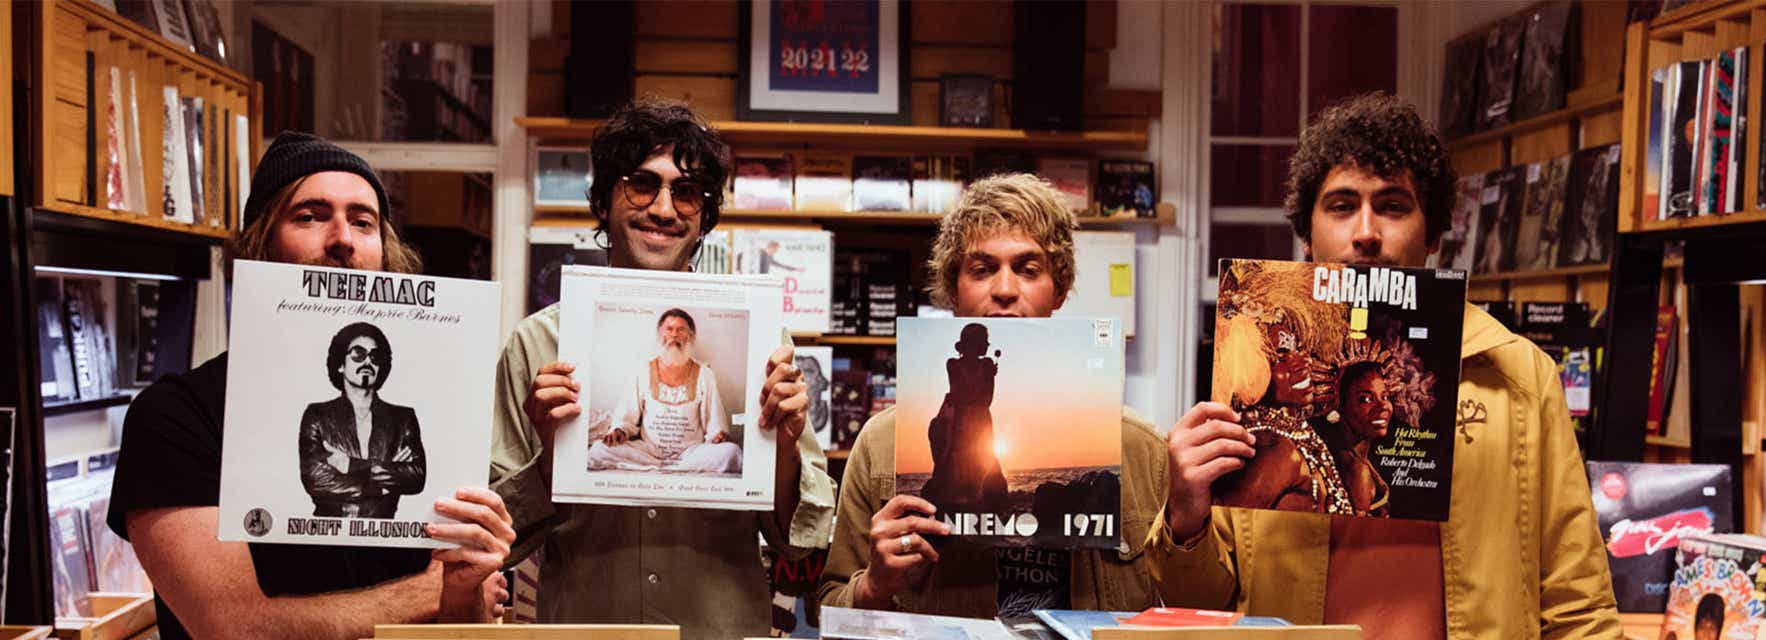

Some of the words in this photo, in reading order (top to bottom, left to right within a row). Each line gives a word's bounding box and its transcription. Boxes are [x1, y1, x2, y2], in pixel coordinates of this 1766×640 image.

[303, 270, 436, 307] TEEMAC
[1312, 266, 1418, 310] CARAMBA
[406, 307, 461, 323] Barnes
[1527, 304, 1563, 314] Record
[1375, 445, 1397, 456] South
[1396, 447, 1427, 457] America
[1405, 477, 1438, 488] Orchestra
[287, 517, 342, 537] NIGHT
[944, 512, 1039, 537] NREMO
[1063, 513, 1114, 537] 1971
